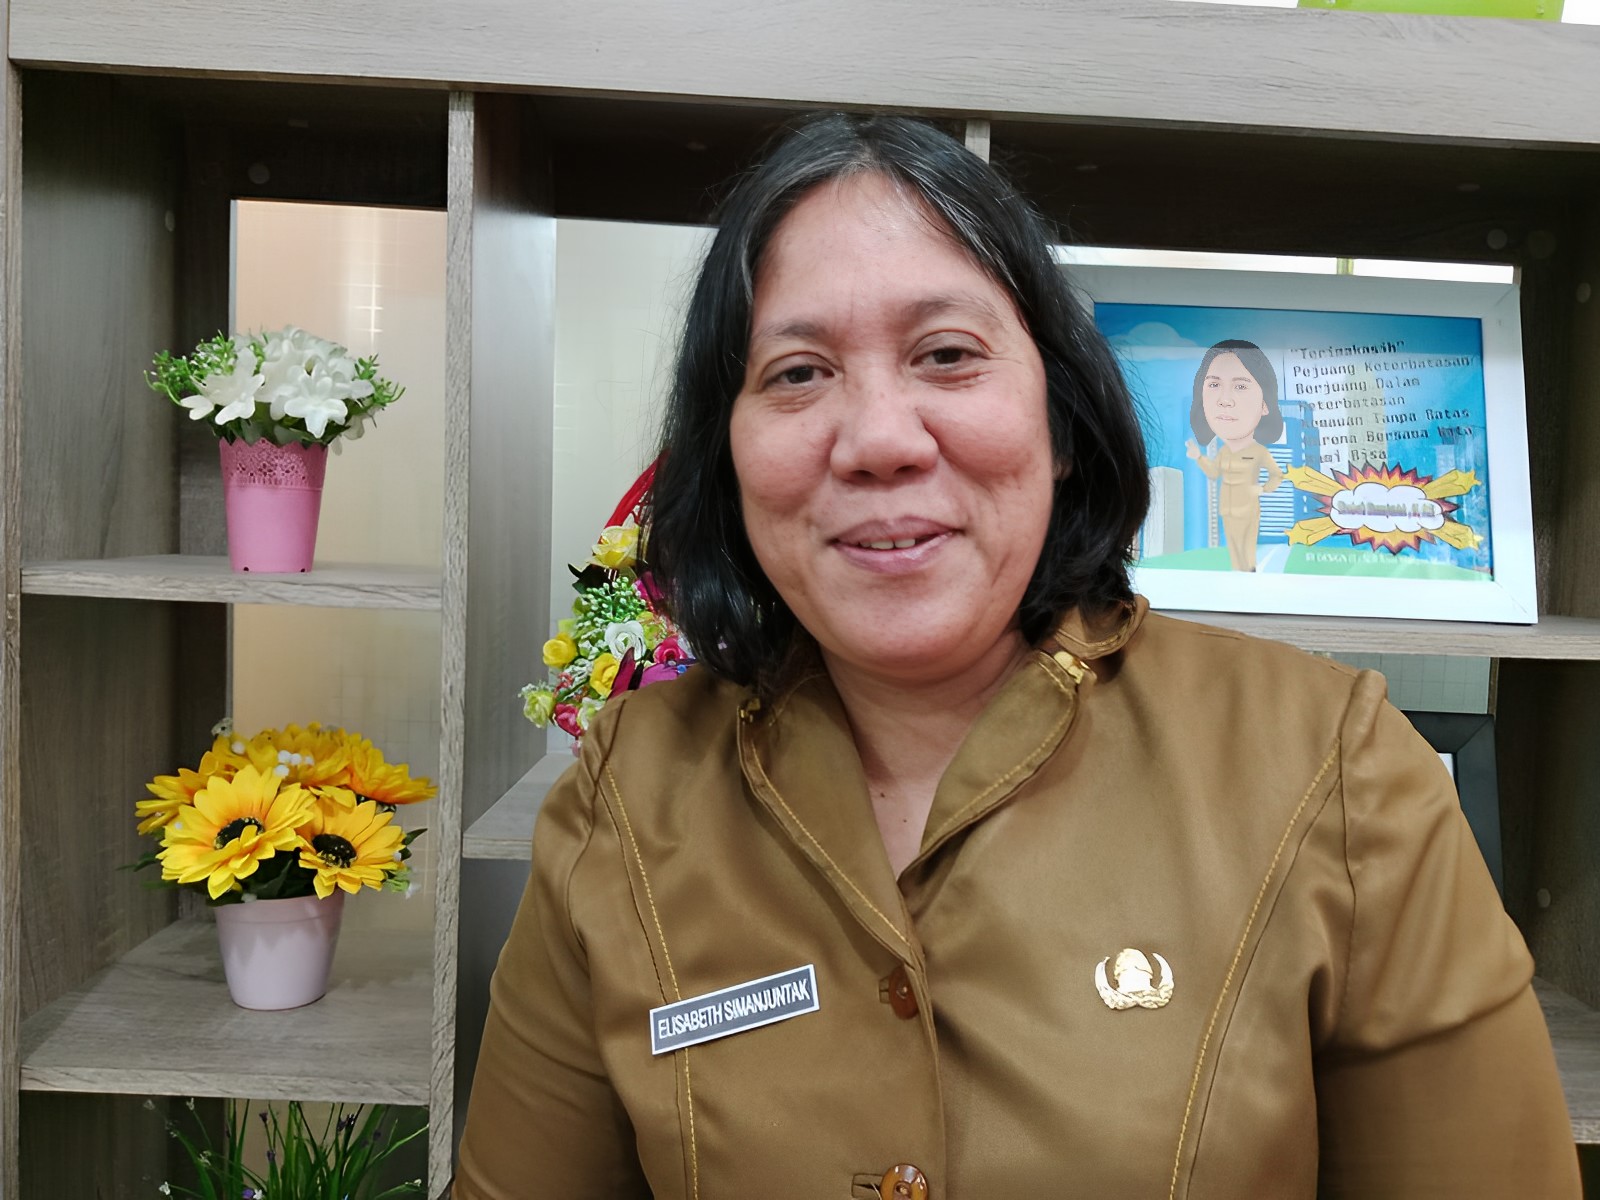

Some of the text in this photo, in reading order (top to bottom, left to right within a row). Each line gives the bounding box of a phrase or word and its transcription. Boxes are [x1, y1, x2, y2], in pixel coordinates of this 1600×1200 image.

[1293, 364, 1356, 378] Pejuang
[1295, 380, 1367, 395] Berjuang
[658, 978, 811, 1040] ELISABETH SIMANJUNTAK
